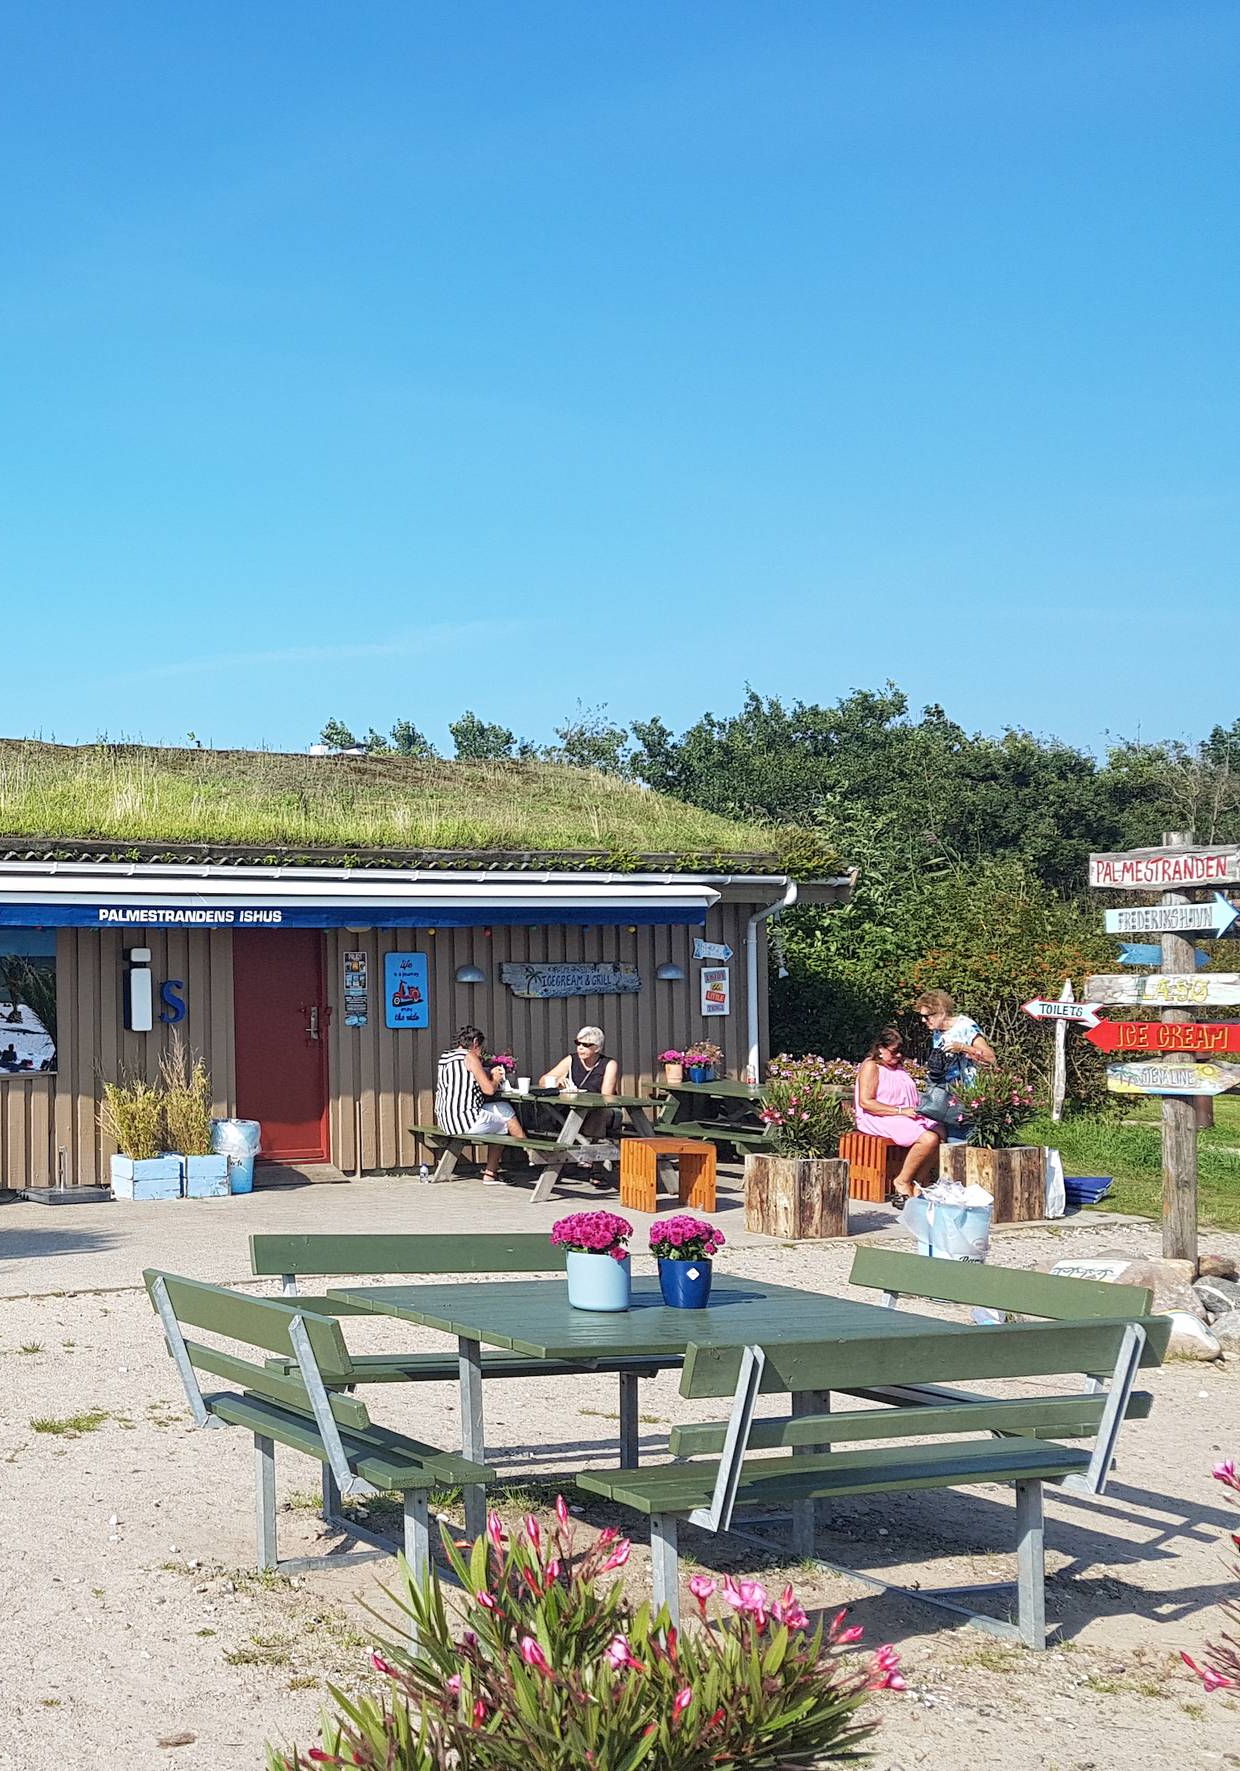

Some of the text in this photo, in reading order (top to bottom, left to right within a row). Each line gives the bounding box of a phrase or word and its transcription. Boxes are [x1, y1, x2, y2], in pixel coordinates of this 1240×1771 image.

[1095, 856, 1227, 883] PALMESTRANDEN
[99, 909, 282, 923] PALMESTRANDENS ISHUS
[1117, 906, 1213, 931] FREDERIKSHAVN
[592, 974, 612, 986] GRILL
[1039, 1003, 1083, 1017] TOILETS
[1117, 1024, 1228, 1049] ICE CREAM
[1170, 1069, 1194, 1085] LINE
